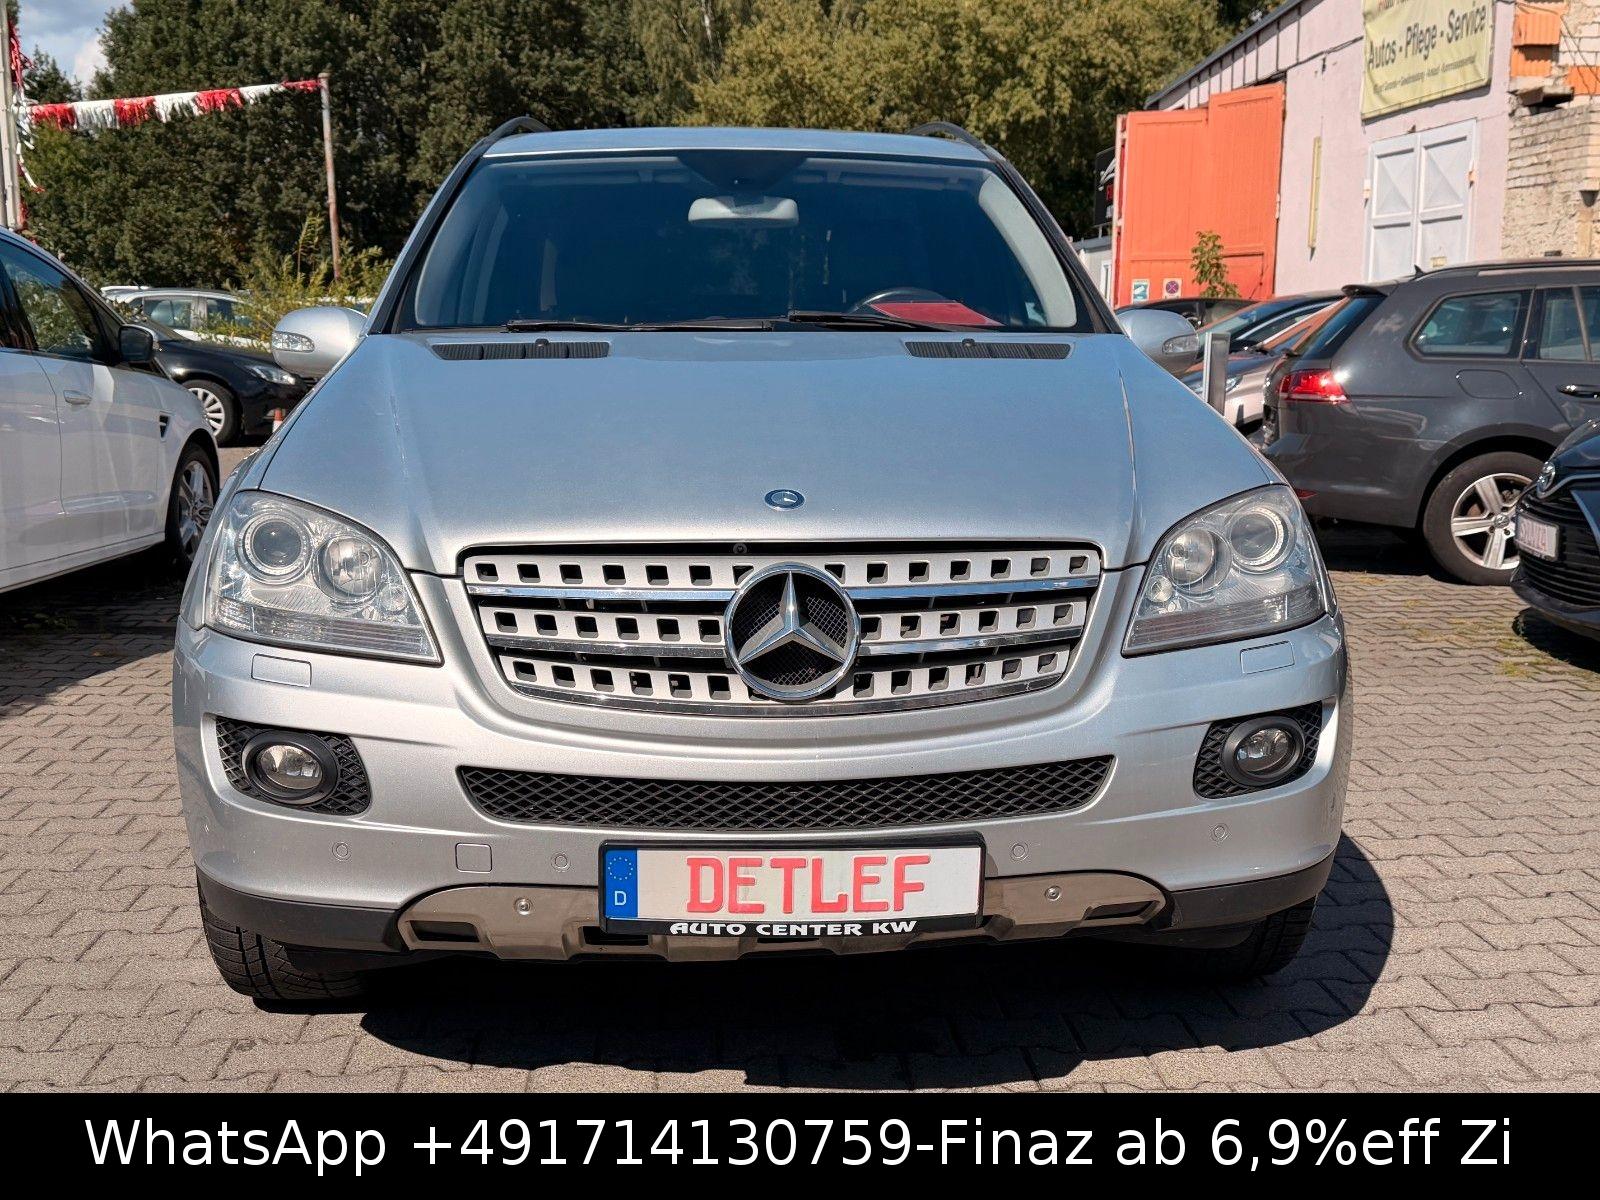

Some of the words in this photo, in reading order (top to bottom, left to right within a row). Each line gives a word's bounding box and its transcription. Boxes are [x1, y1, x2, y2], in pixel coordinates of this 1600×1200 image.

[1368, 39, 1396, 70] Autos
[1405, 22, 1437, 61] Pflege
[1446, 1, 1486, 44] Service
[614, 890, 627, 907] D
[686, 855, 931, 914] DETLEF
[669, 922, 747, 936] AUTO
[756, 922, 864, 937] CENTER
[872, 920, 918, 935] KW
